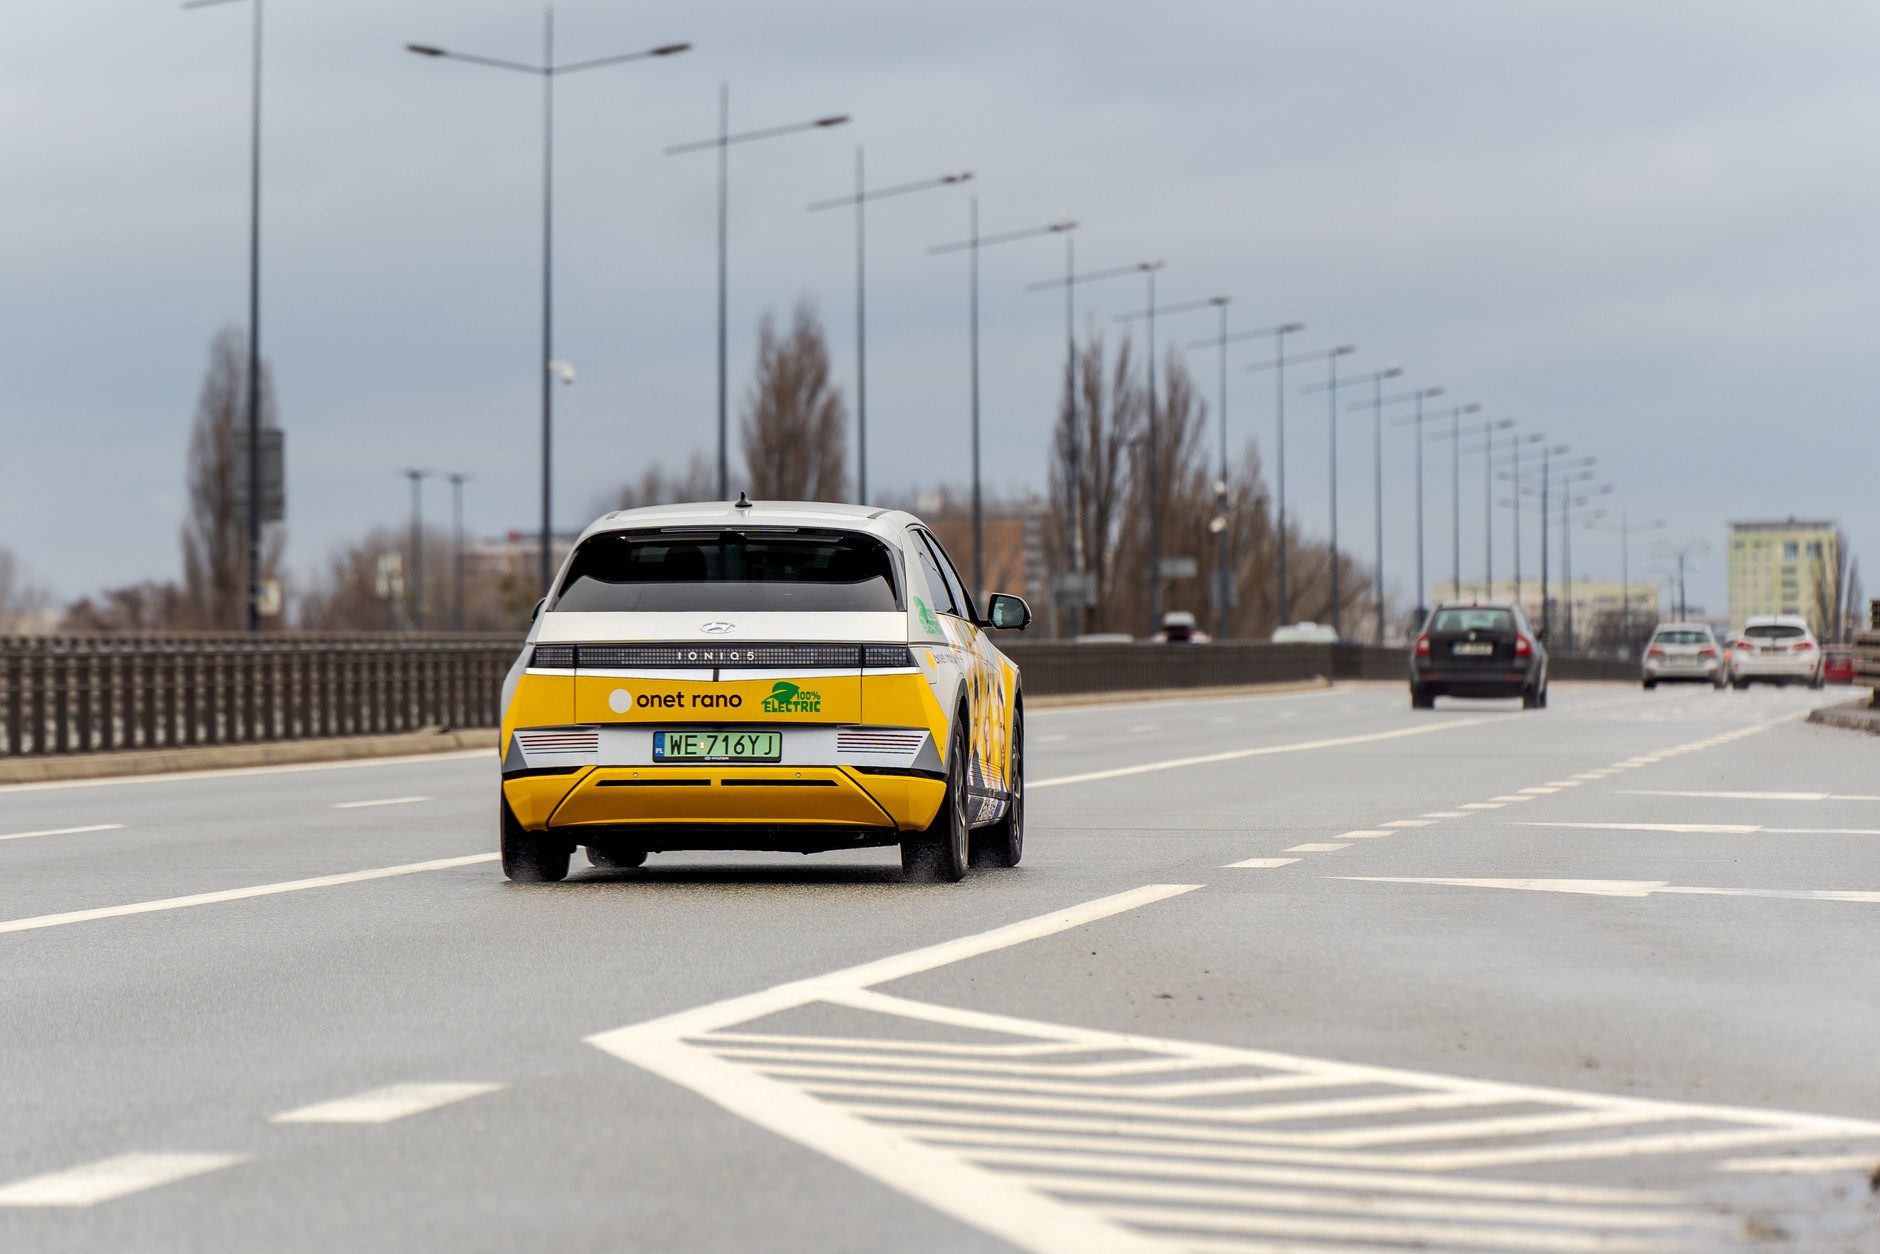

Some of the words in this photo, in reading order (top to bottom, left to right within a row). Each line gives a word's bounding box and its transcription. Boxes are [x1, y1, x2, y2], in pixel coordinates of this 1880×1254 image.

[637, 691, 684, 708] onet
[692, 694, 742, 708] rano
[796, 691, 821, 700] 100%
[764, 700, 821, 713] ELECTRIC
[670, 735, 698, 756] WE
[706, 735, 773, 756] 716YJ
